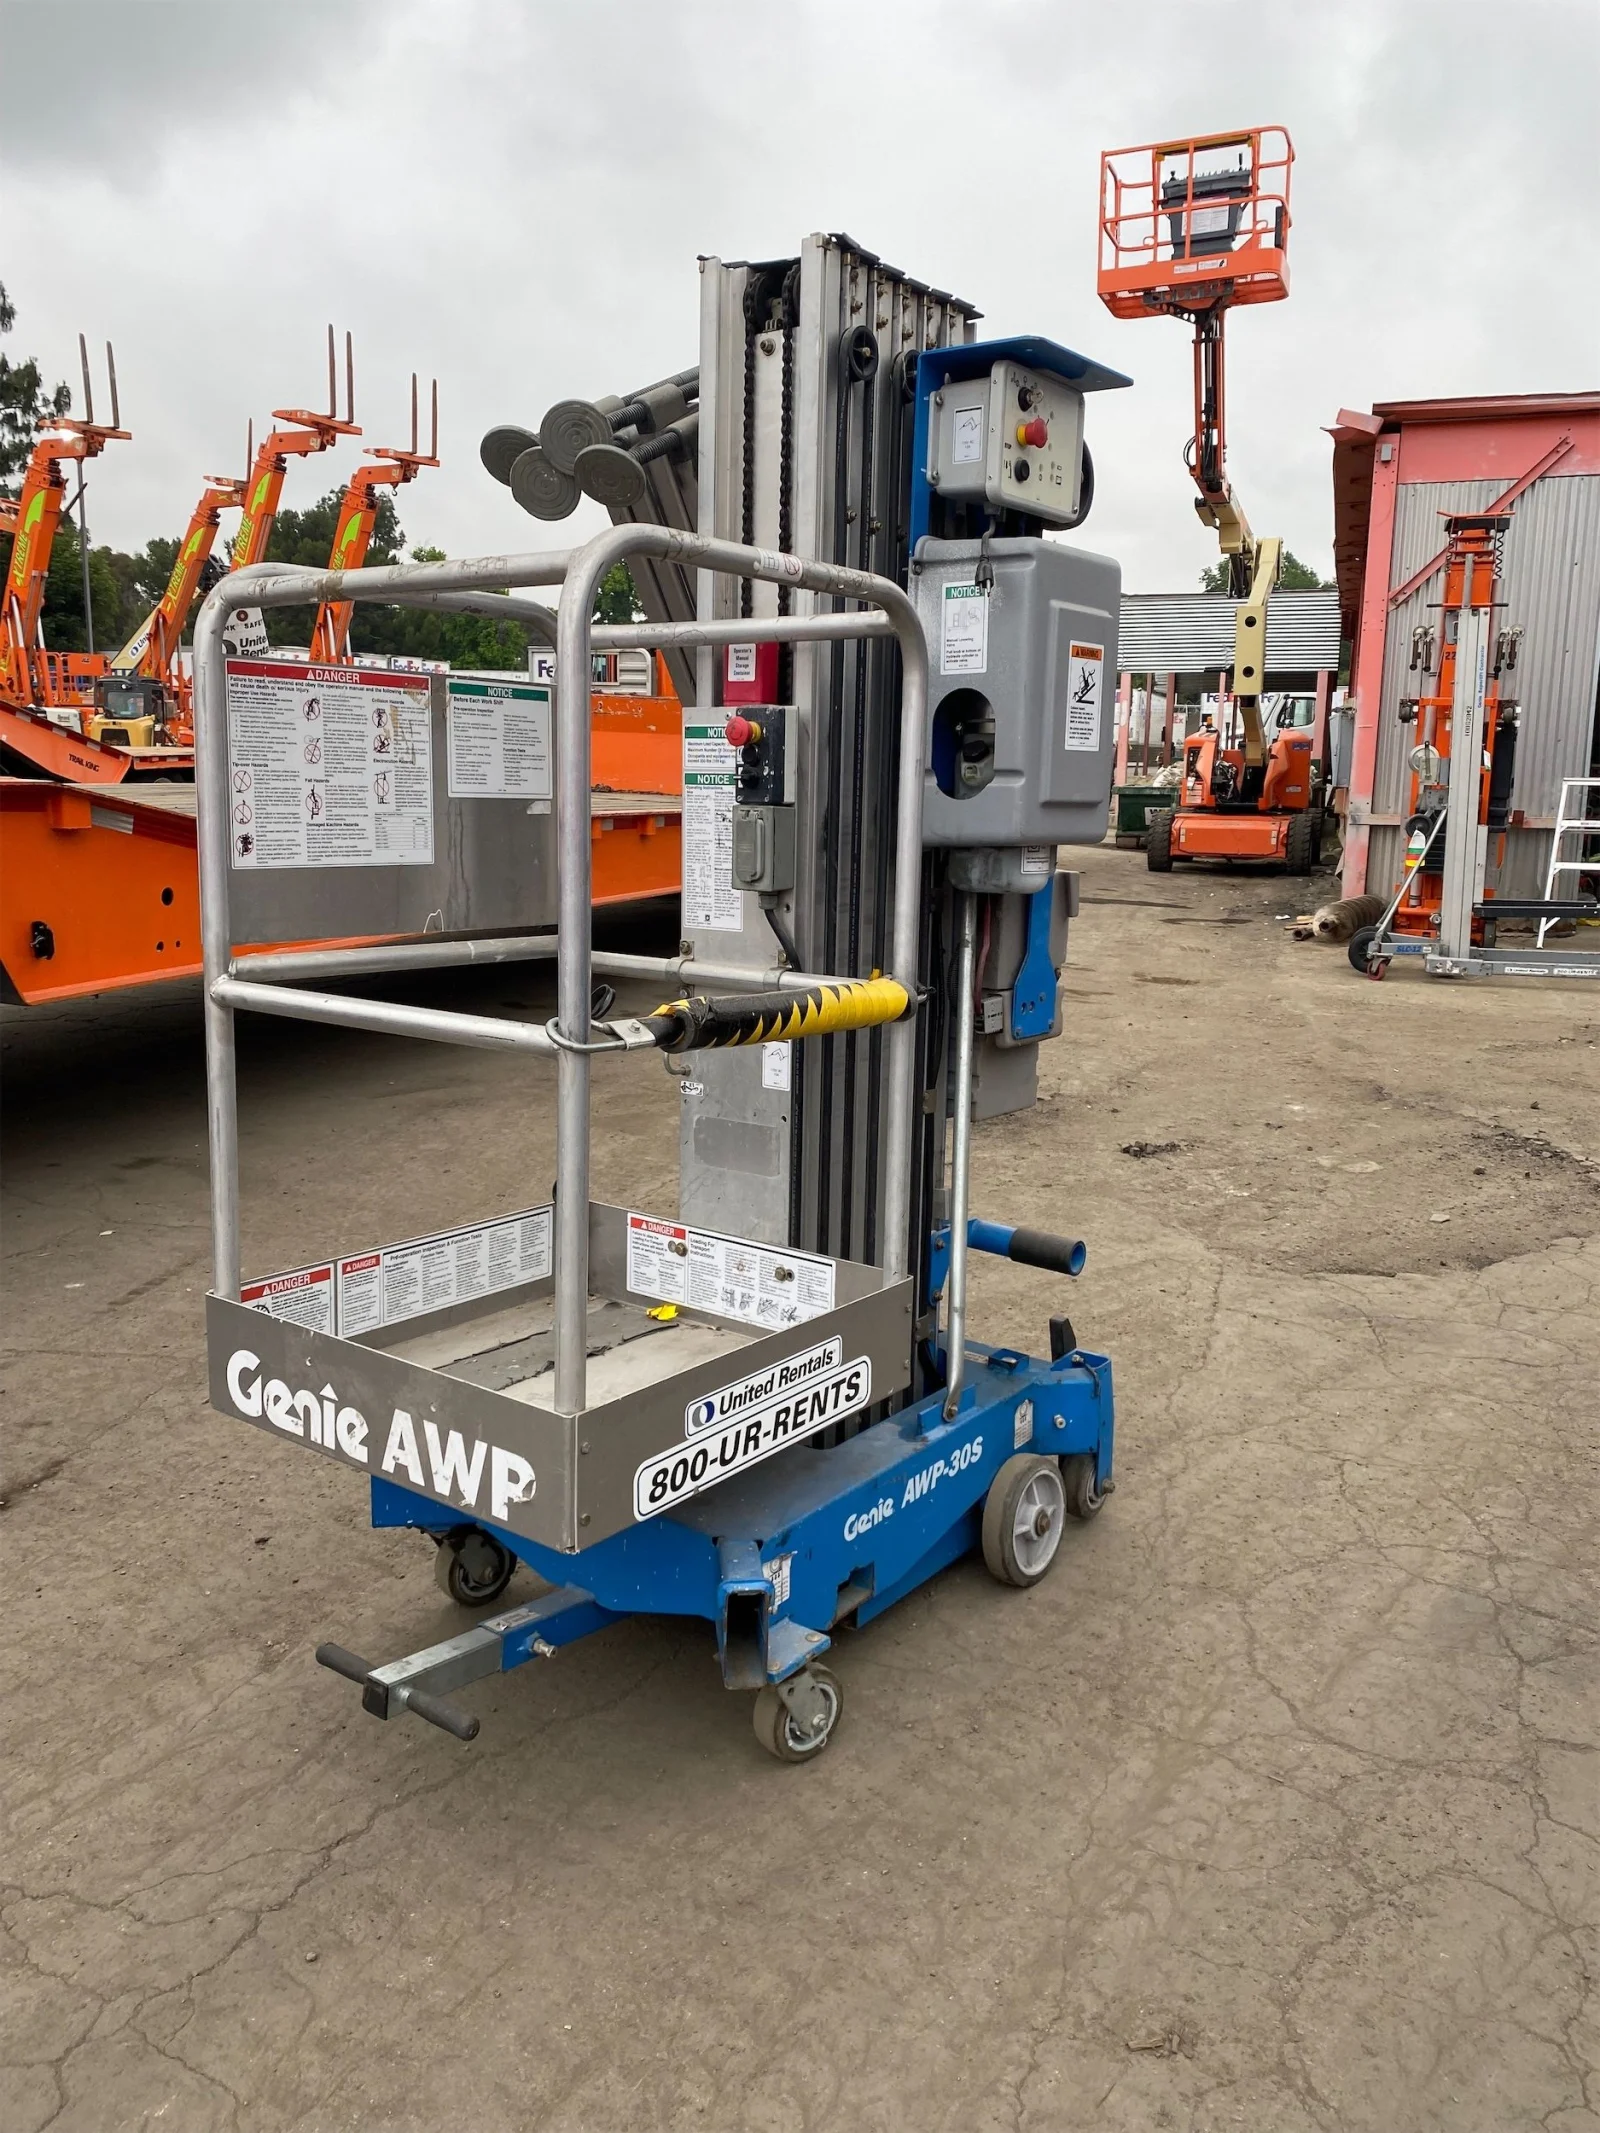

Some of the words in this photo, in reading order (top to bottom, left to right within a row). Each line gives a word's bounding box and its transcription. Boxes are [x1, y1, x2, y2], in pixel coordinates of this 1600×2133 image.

[951, 586, 980, 598] NOTICE
[1080, 648, 1099, 659] WARNING
[316, 669, 360, 684] DANGER
[488, 687, 513, 698] NOTICE
[68, 753, 85, 767] TRAIL
[85, 760, 100, 773] KING
[698, 774, 730, 784] NOTICE
[648, 1222, 675, 1236] DANGER
[422, 1243, 446, 1253] Inspection
[450, 1237, 470, 1246] Function
[690, 1238, 707, 1246] Loading
[690, 1244, 710, 1252] Transport
[690, 1250, 715, 1260] Instructions
[352, 1258, 376, 1270] DANGER
[272, 1274, 310, 1294] DANGER
[719, 1370, 774, 1416] United
[778, 1348, 834, 1388] Rentals
[226, 1349, 370, 1464] Genie
[648, 1370, 861, 1504] 800-UR-RENTS
[381, 1408, 536, 1522] AWP
[901, 1436, 984, 1508] AWP-30S
[844, 1498, 894, 1542] Genie
